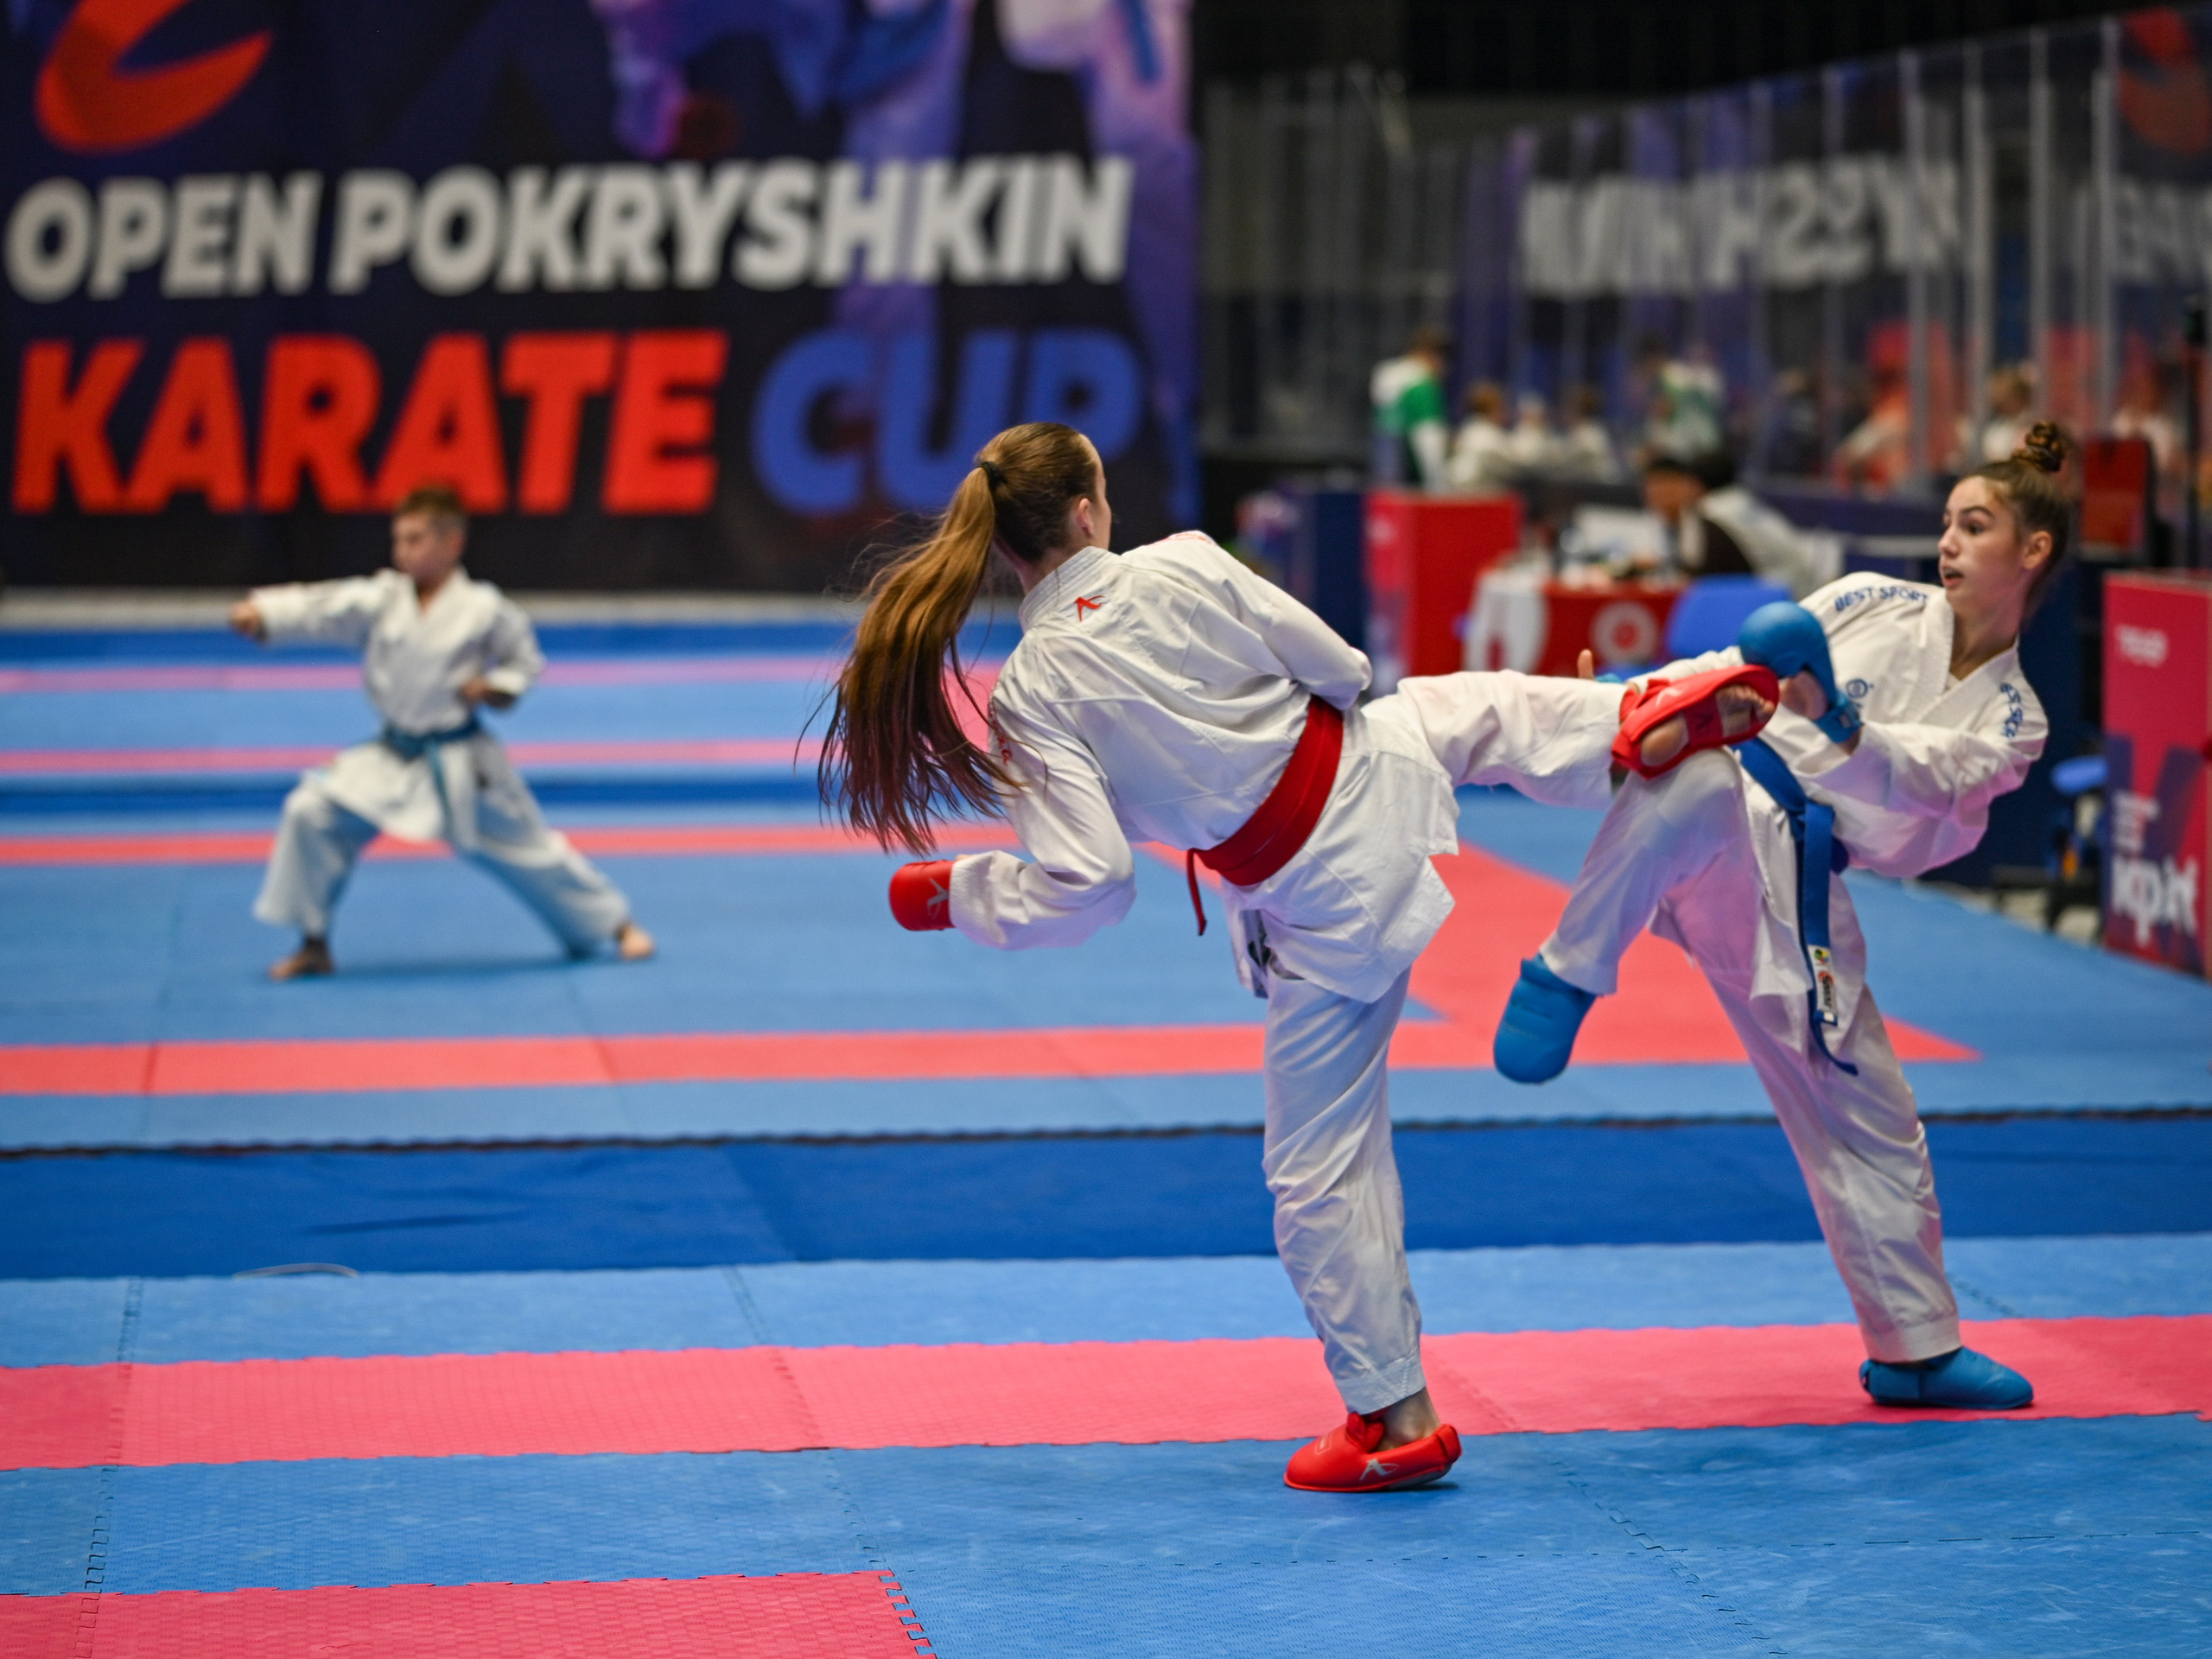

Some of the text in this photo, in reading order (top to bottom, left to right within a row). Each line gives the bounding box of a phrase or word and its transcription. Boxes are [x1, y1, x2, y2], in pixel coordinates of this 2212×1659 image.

[6, 154, 1135, 302] OPEN POKRYSHKIN
[12, 327, 1141, 514] KARATE CUP
